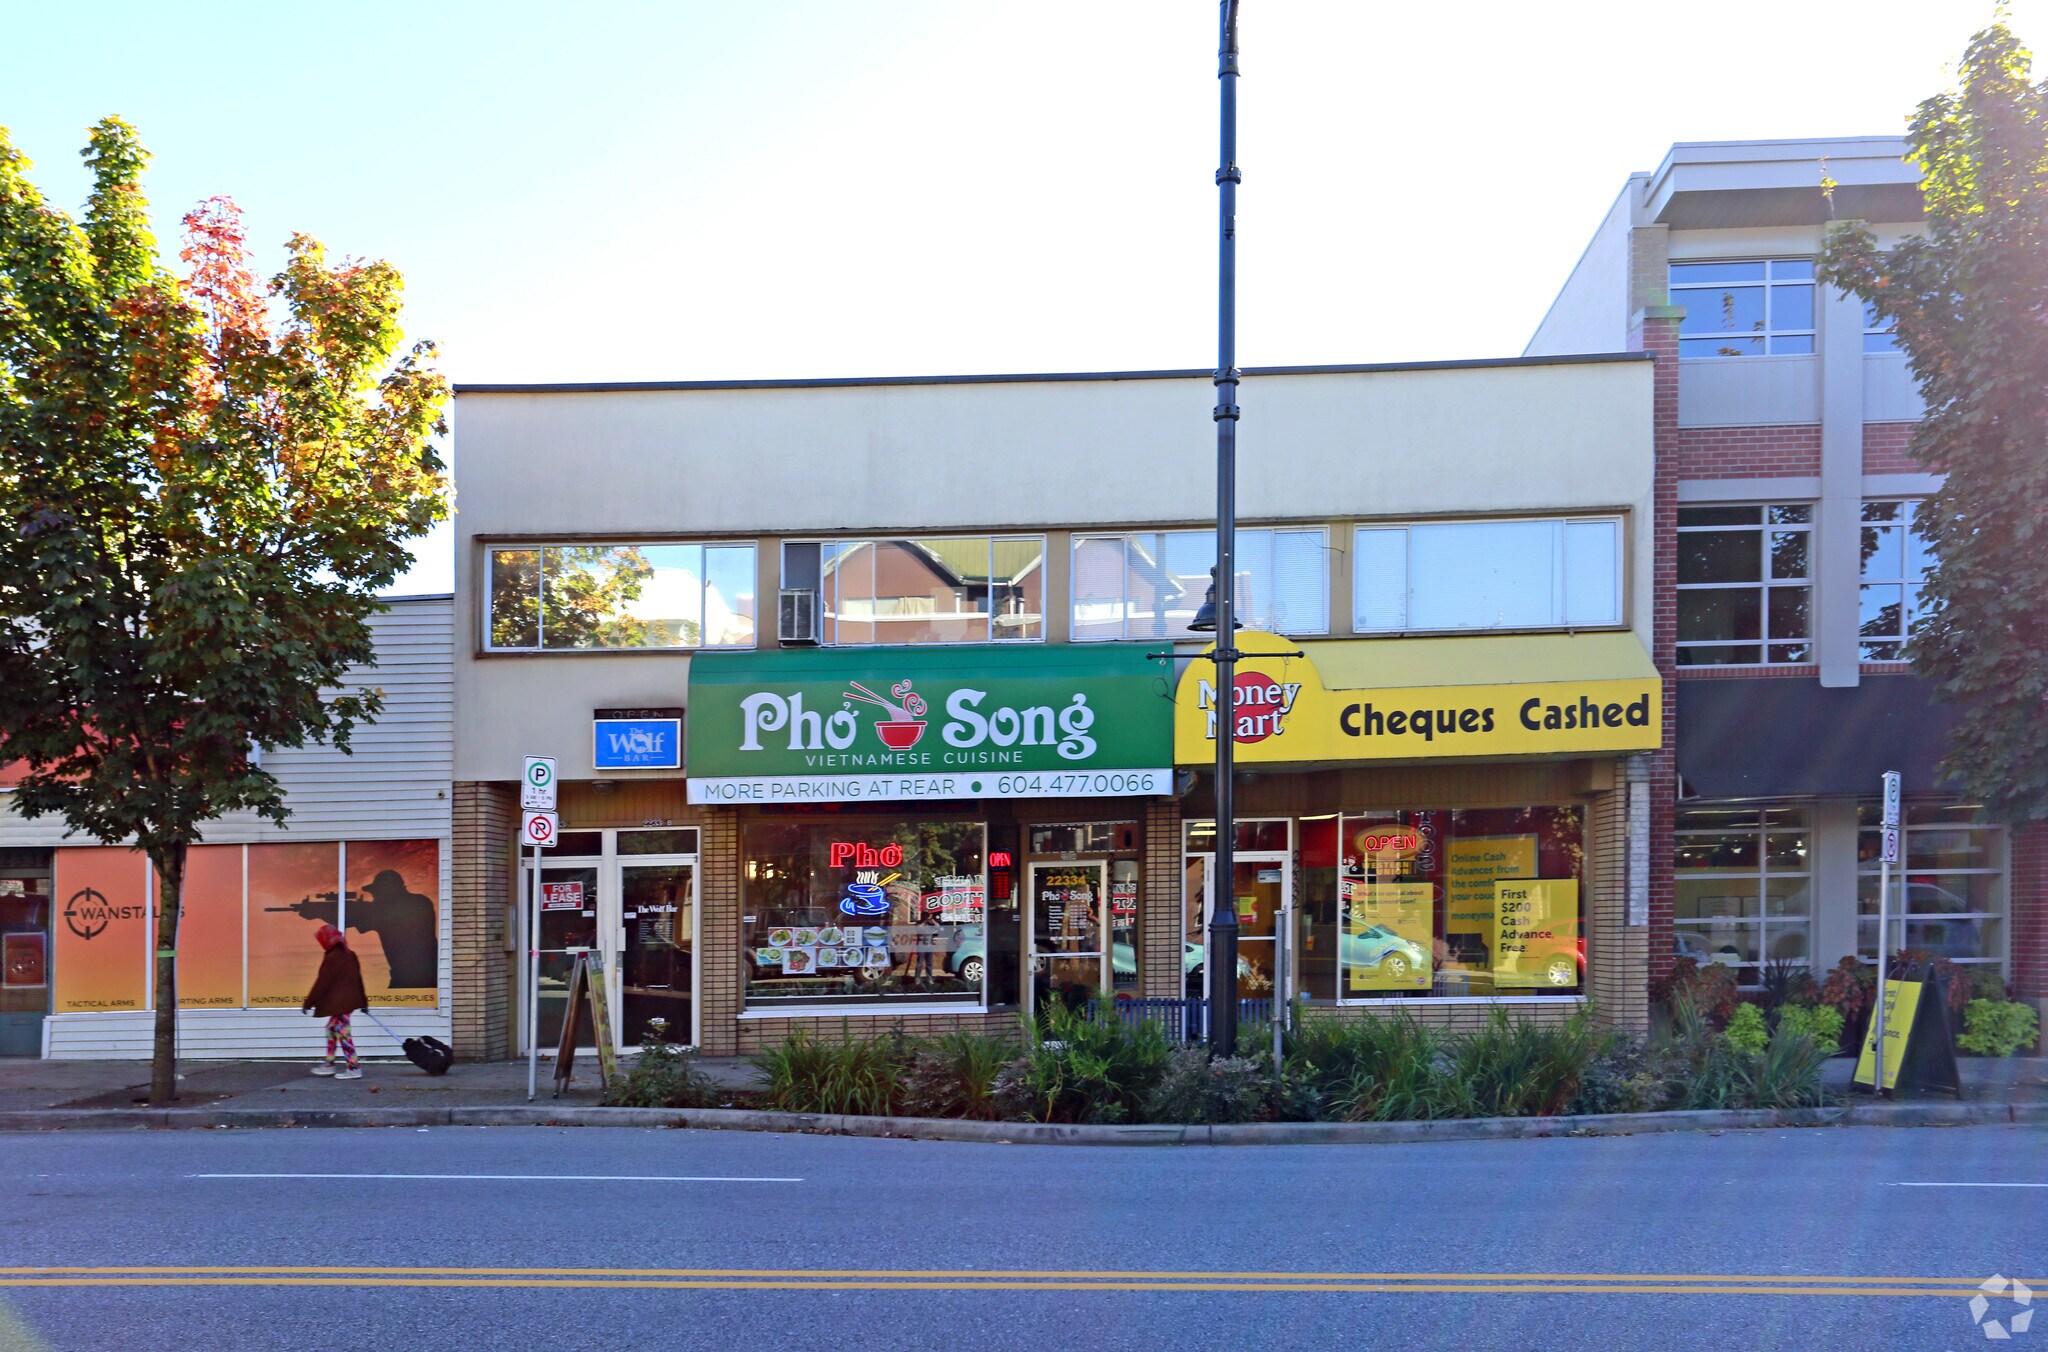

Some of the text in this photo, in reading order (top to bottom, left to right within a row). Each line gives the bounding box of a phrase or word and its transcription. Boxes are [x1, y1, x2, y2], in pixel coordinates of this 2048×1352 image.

[612, 710, 664, 718] OPEN
[1340, 693, 1649, 741] Cheques Cashed
[942, 688, 1098, 760] Song
[608, 732, 664, 754] Wolf
[624, 754, 649, 762] BAR
[805, 751, 1024, 768] VIETNAMESE CUISINE
[535, 768, 546, 781] P
[705, 773, 1154, 799] MORE PARKING AT REAR 604.477.0066
[1365, 835, 1417, 851] OPEN
[989, 852, 1011, 867] OPEN
[1451, 853, 1507, 863] Online Cash
[1361, 861, 1410, 869] WESTERN
[1451, 865, 1520, 875] Advances from
[1046, 875, 1087, 886] 22334
[1451, 879, 1466, 888] the
[552, 884, 572, 893] FOR
[543, 892, 581, 903] LEASE
[1070, 890, 1094, 902] Song
[1451, 893, 1471, 902] your
[1501, 889, 1528, 899] First
[638, 903, 678, 913] The Wolf Bar
[1501, 902, 1532, 913] $200
[1500, 916, 1530, 926] Cash
[893, 933, 937, 946] COFFEE
[208, 997, 234, 1005] ARMS
[394, 994, 435, 1002] SUPPLIES
[67, 999, 136, 1008] TACTICAL ARMS
